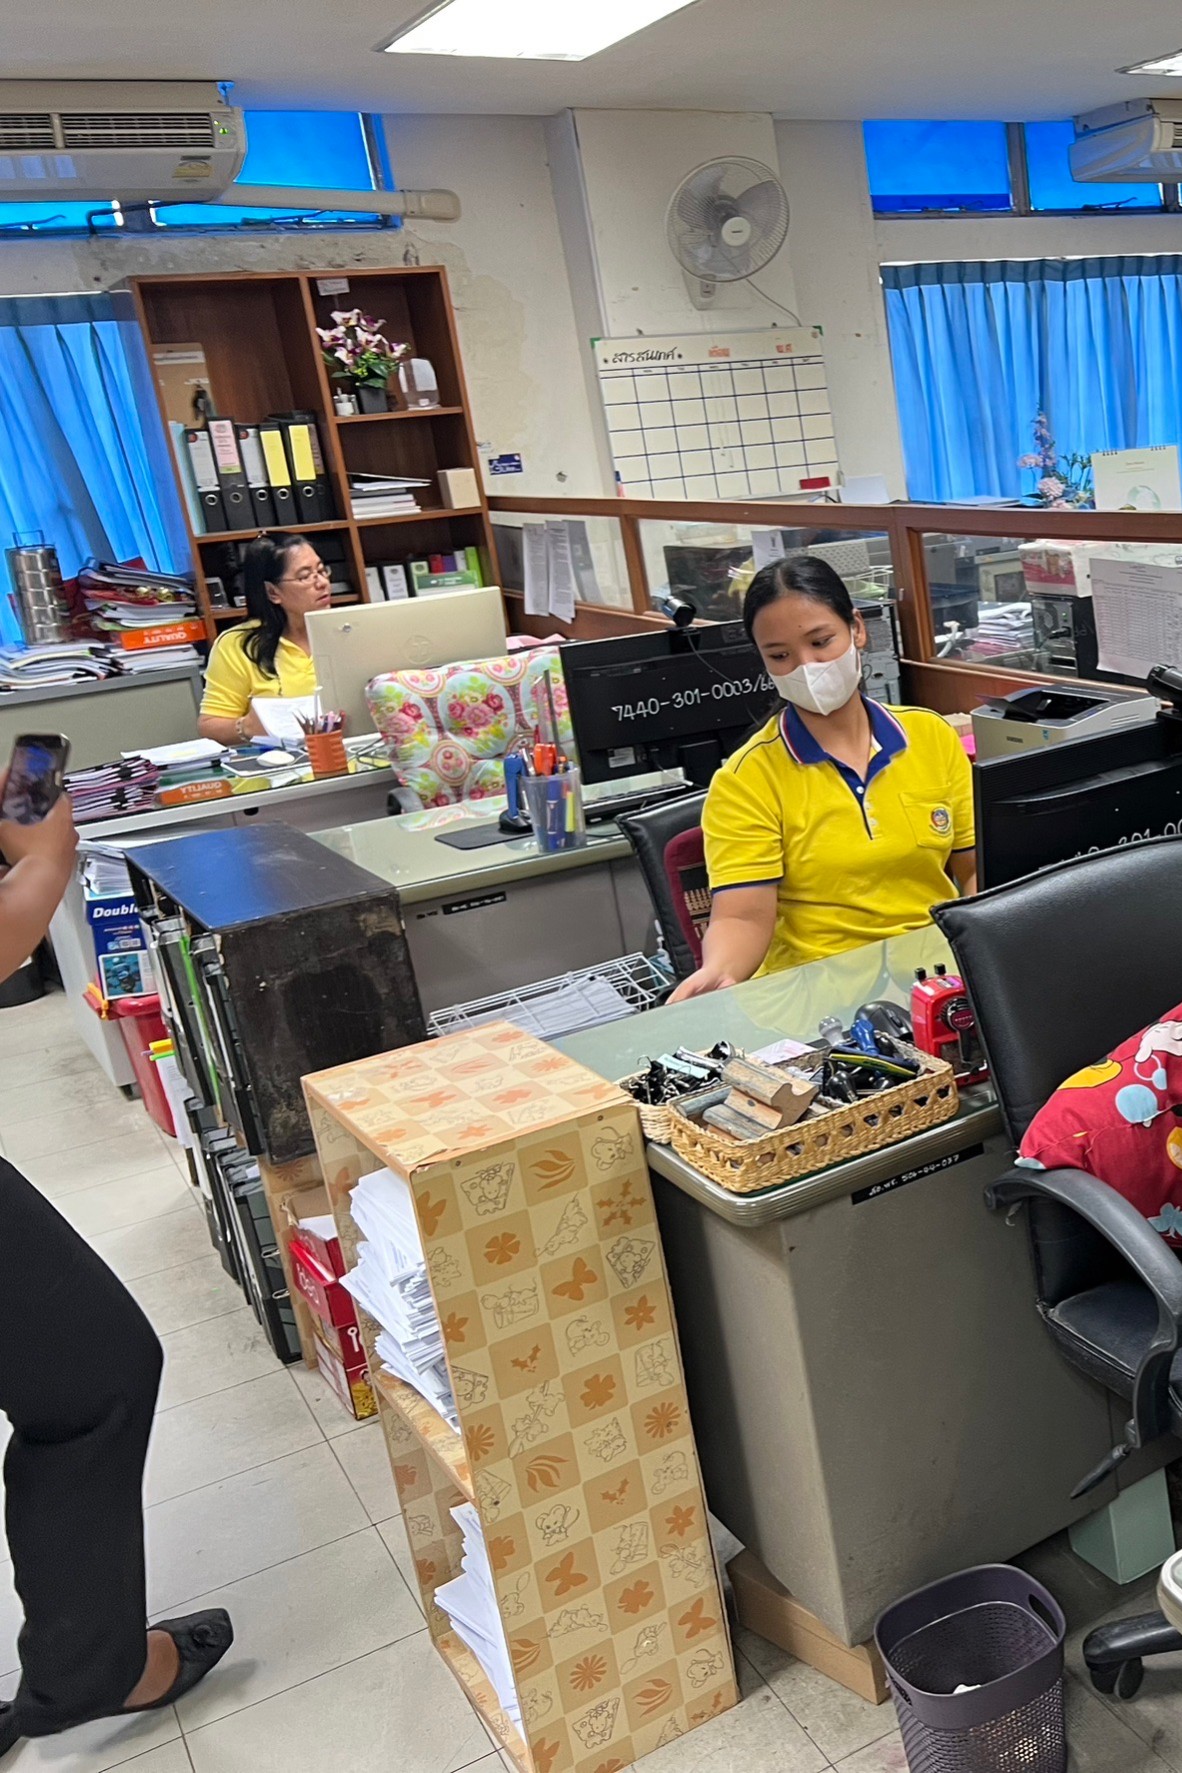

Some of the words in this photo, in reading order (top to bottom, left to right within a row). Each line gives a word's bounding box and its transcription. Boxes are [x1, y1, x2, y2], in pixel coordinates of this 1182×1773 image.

[612, 346, 678, 363] สารสนเทศ
[143, 631, 188, 645] QUALITY
